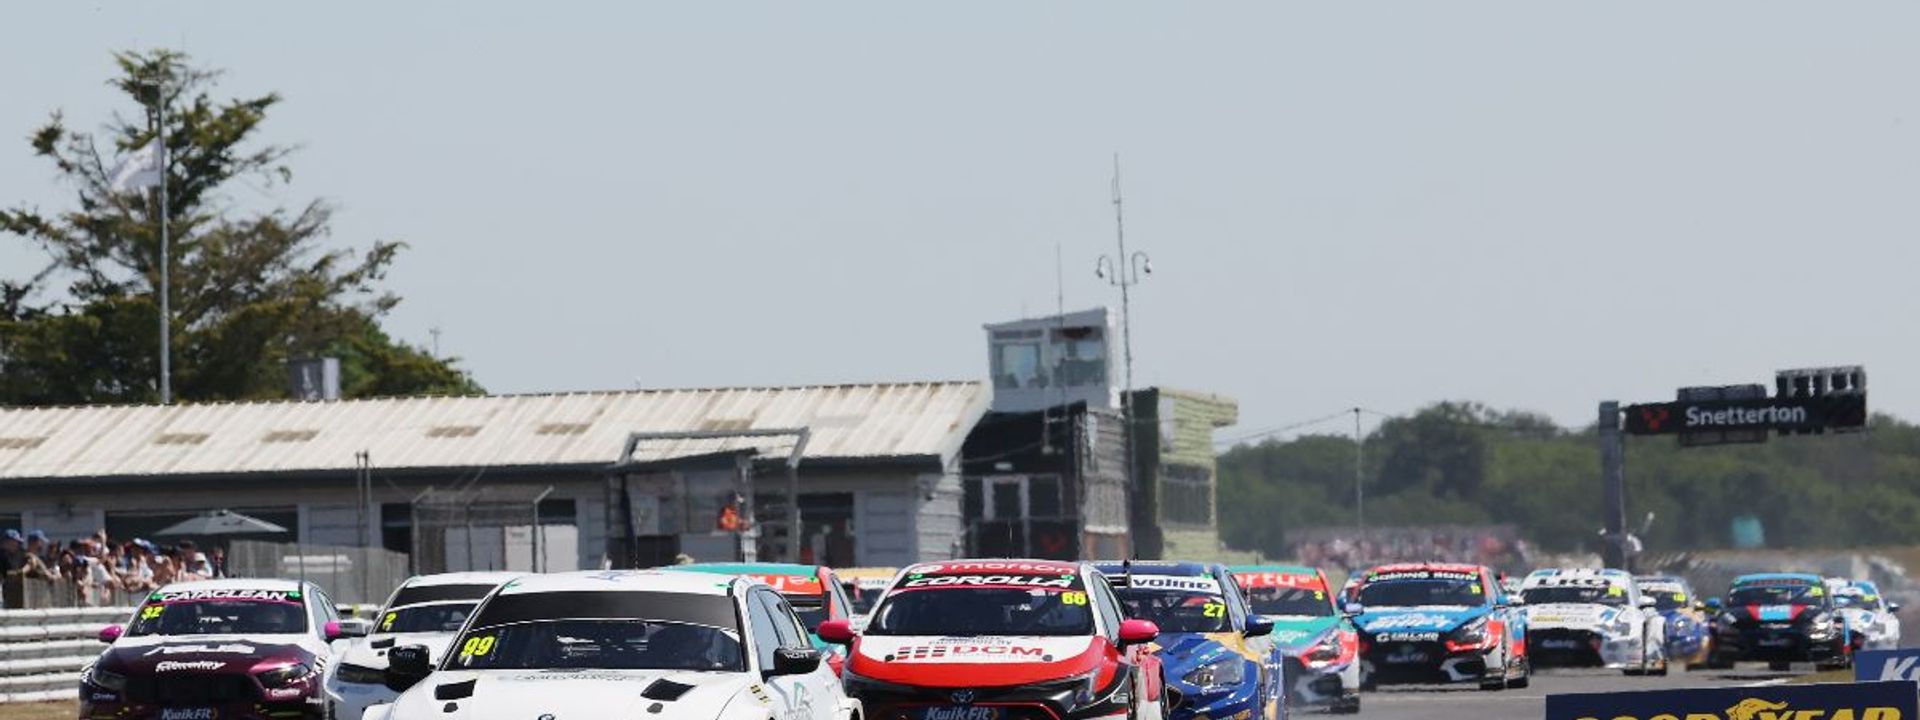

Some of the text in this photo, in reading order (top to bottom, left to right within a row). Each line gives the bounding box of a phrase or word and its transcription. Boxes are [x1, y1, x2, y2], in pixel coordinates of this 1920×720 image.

[1685, 406, 1806, 426] Snetterton
[906, 575, 1072, 588] COROLLA
[161, 590, 288, 602] CATACLEAN
[1203, 603, 1226, 618] 27
[461, 636, 495, 656] 99
[952, 646, 1043, 656] DCM
